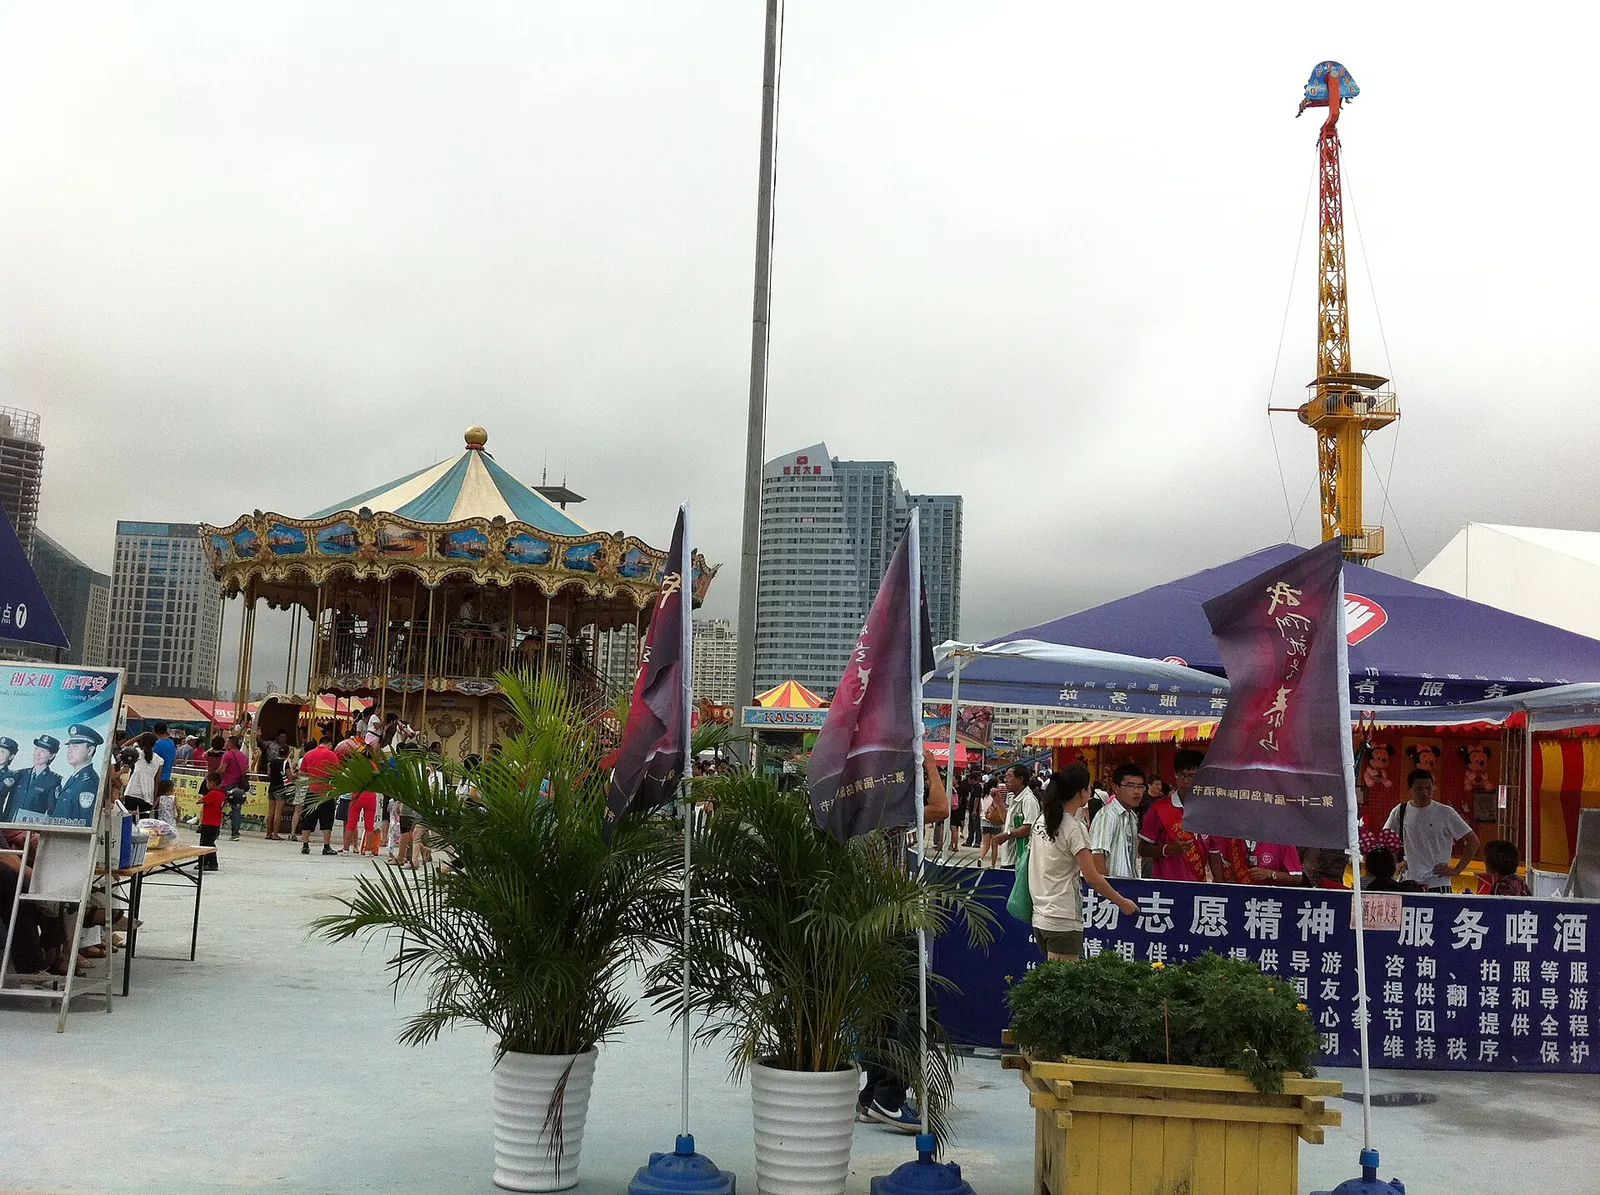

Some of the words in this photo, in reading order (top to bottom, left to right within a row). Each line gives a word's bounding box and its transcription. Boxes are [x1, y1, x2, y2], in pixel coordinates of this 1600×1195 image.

[17, 604, 26, 628] 7
[10, 671, 56, 688] 创文明
[61, 674, 108, 692] 保平安
[1357, 695, 1432, 706] Station
[764, 712, 813, 724] KASSE
